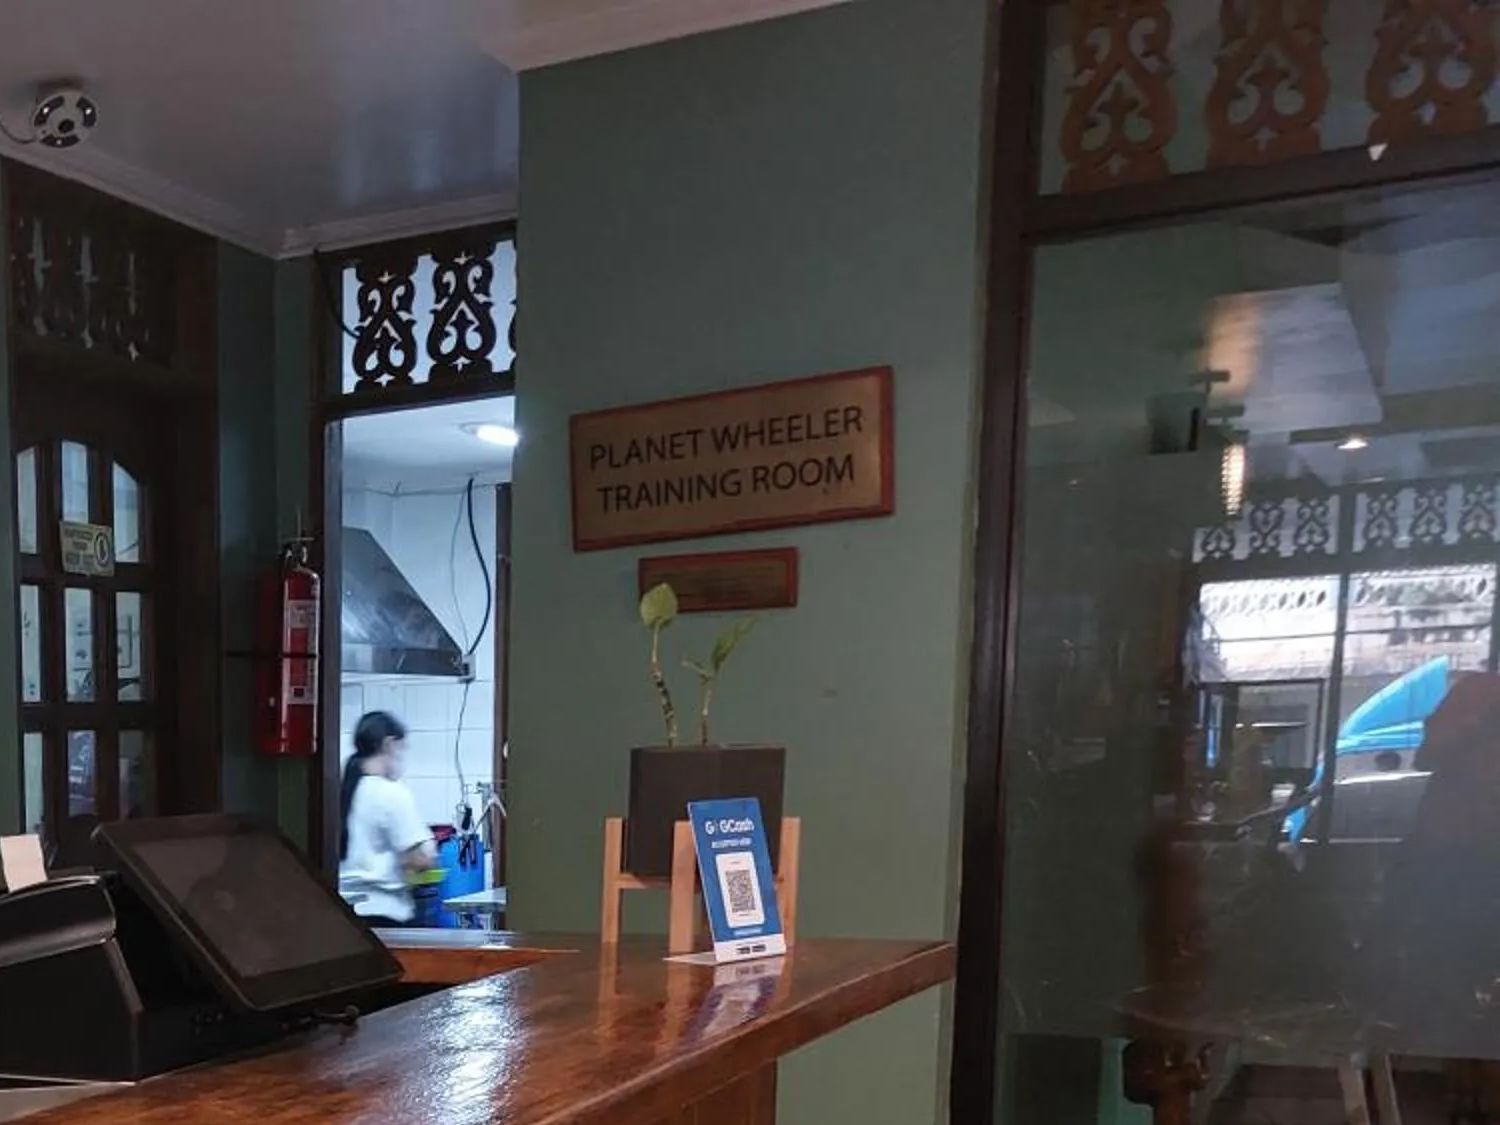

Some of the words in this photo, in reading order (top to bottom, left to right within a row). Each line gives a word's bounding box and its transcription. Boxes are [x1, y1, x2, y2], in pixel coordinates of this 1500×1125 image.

[589, 429, 705, 471] PLANET
[711, 406, 863, 455] WHEELER
[596, 468, 742, 514] TRAINING
[752, 453, 855, 493] ROOM
